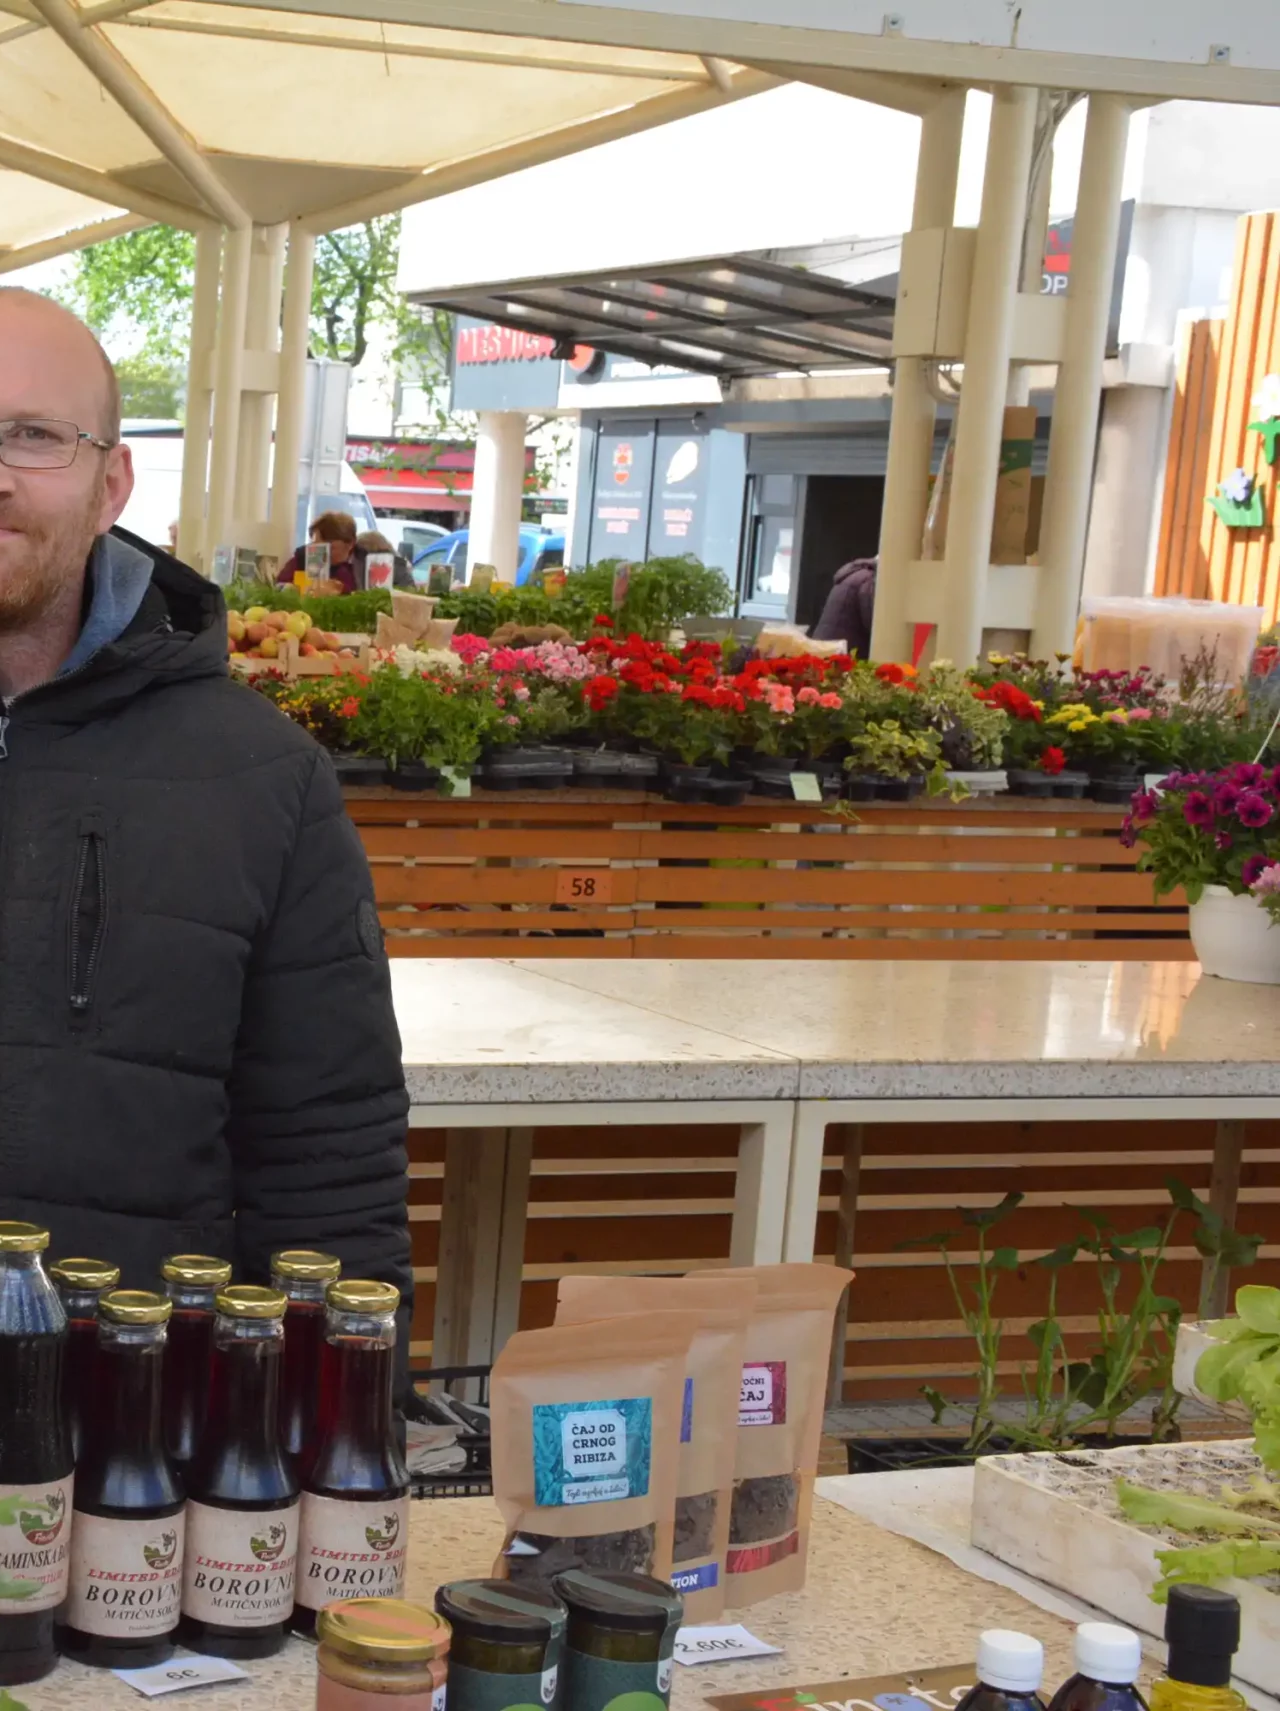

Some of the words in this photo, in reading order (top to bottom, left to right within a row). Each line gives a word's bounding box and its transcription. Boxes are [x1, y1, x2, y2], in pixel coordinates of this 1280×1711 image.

[571, 877, 596, 897] 58
[742, 1376, 765, 1386] OČNI
[571, 1423, 595, 1435] ČAJ
[599, 1423, 616, 1433] OD
[572, 1437, 616, 1449] CRNOG
[573, 1451, 617, 1464] RIBIZA
[310, 1546, 380, 1562] LIMITED
[196, 1555, 266, 1573] LIMITED
[87, 1568, 160, 1582] LIMITED
[210, 1596, 261, 1610] MATIČNI
[262, 1596, 281, 1609] SOK
[105, 1608, 155, 1620] MATIČNI
